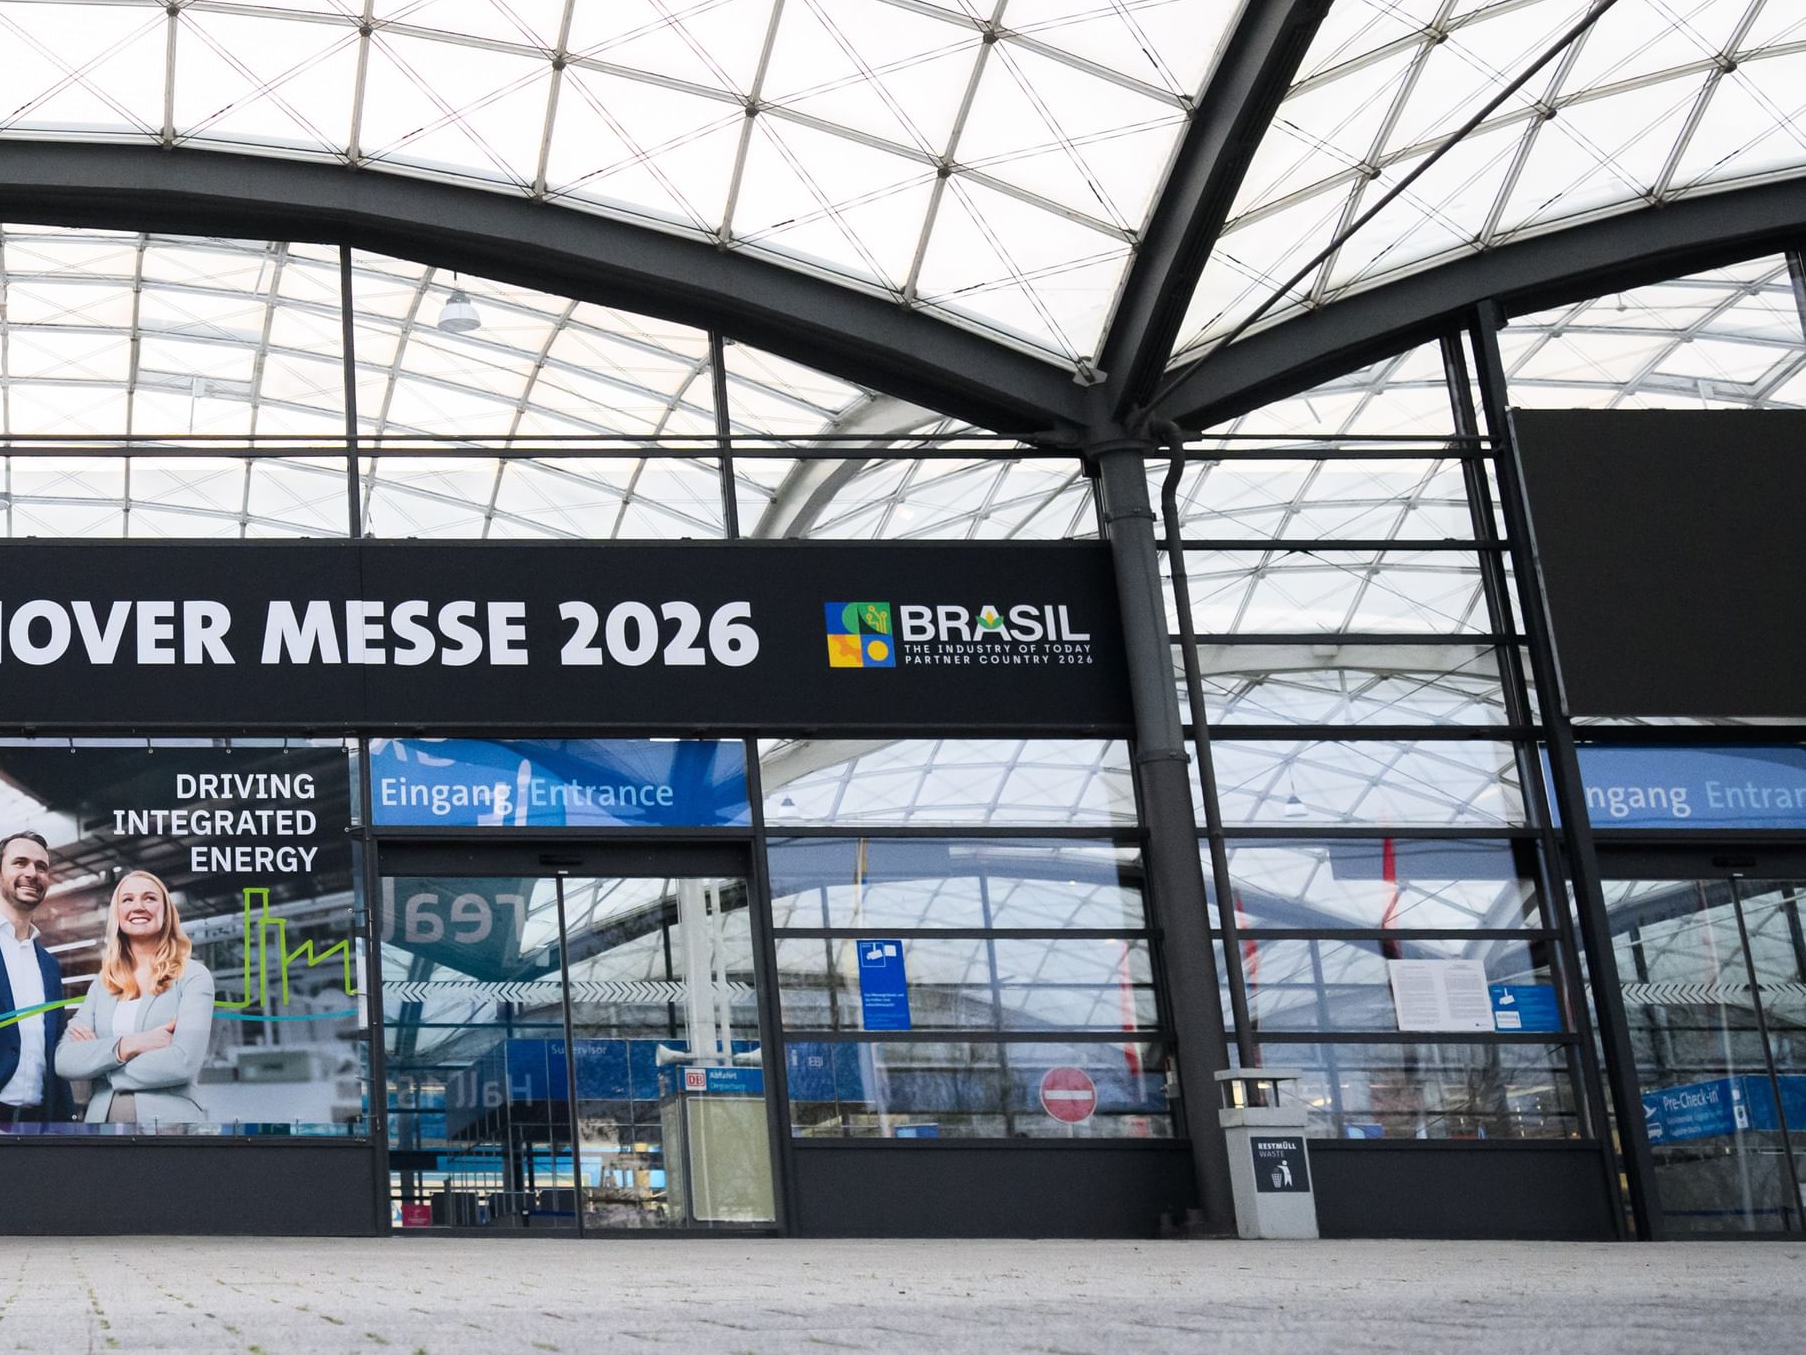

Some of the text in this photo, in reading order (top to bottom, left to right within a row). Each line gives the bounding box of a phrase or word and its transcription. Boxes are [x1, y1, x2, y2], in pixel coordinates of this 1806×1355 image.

[261, 600, 529, 666] MESSE
[558, 600, 760, 667] 2026
[899, 604, 1091, 642] BRASIL
[905, 644, 1091, 654] THE INDUSTRY OF TODAY
[905, 655, 1093, 664] PARTNER COUNTRY 2026
[176, 773, 315, 799] DRIVING
[381, 777, 674, 816] Eingang Entrance
[1586, 787, 1692, 818] ngang
[113, 809, 317, 836] INTEGRATED
[190, 846, 319, 872] ENERGY
[688, 1074, 704, 1085] DB
